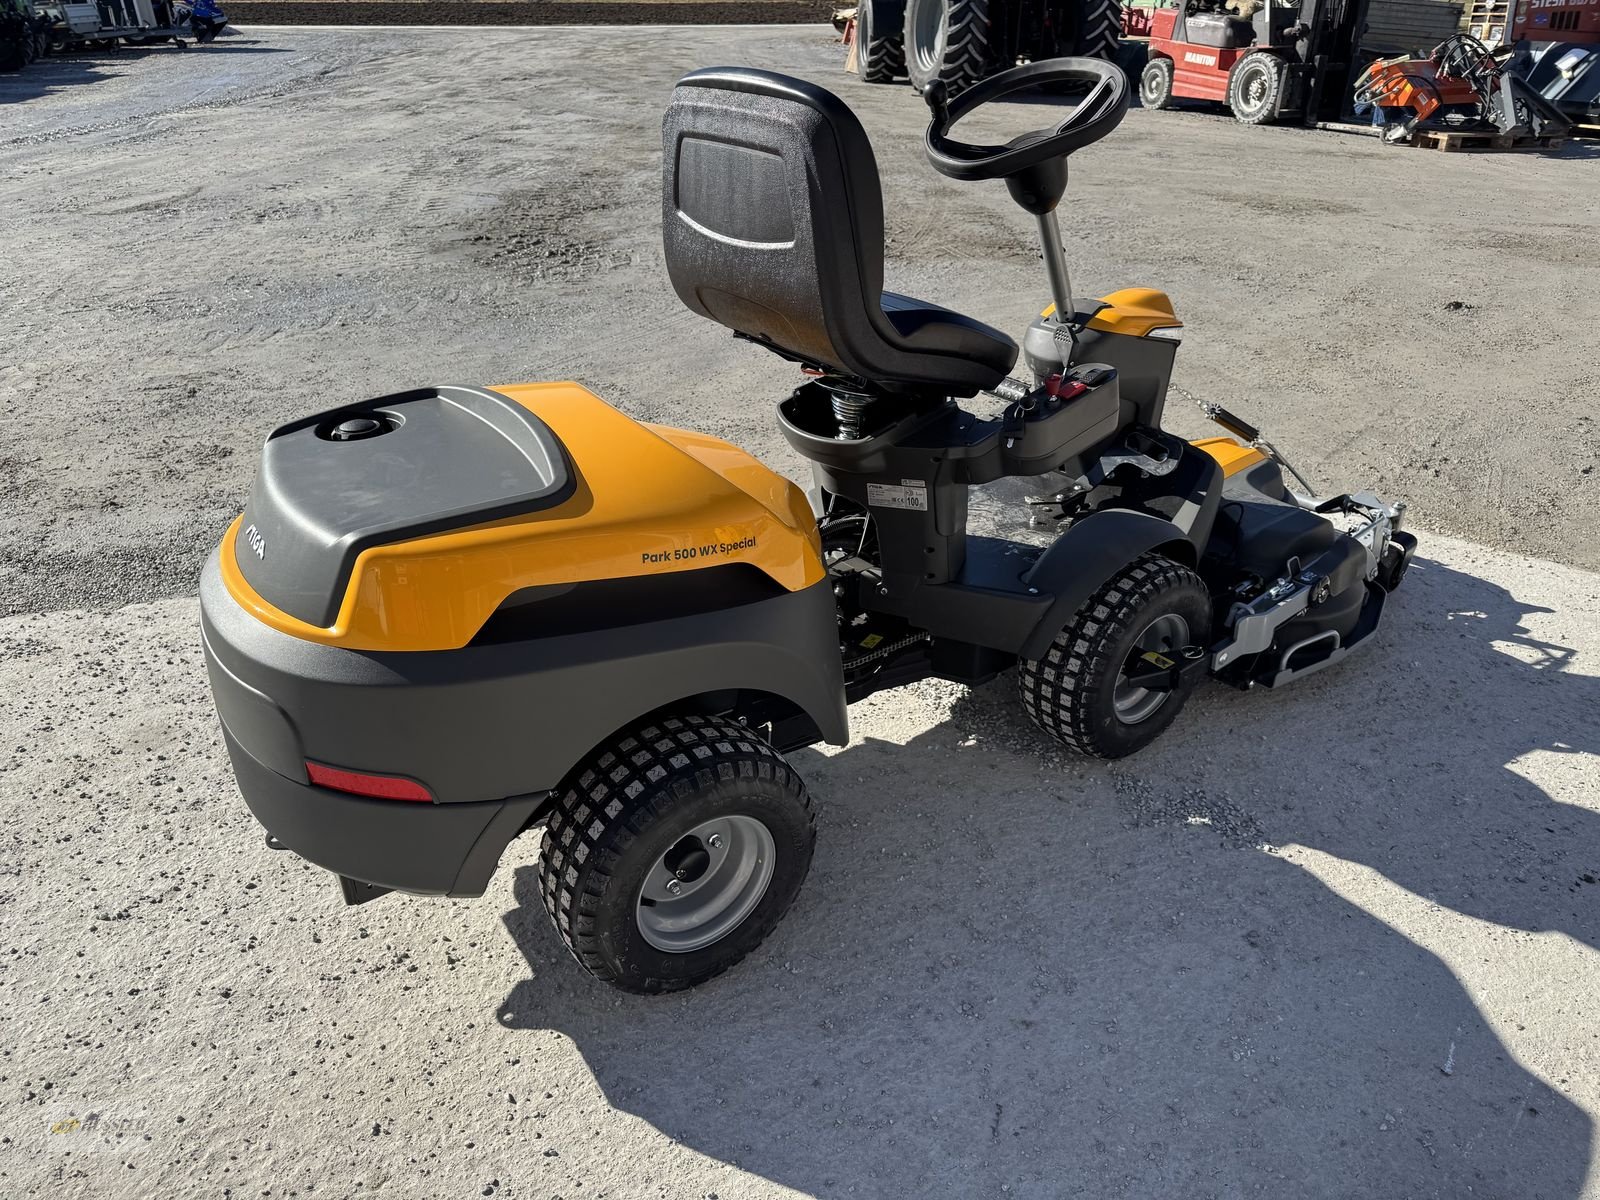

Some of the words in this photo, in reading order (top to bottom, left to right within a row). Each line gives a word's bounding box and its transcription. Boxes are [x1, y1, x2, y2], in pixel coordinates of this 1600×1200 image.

[1184, 51, 1216, 66] MANITOU
[907, 497, 919, 506] 100
[642, 551, 671, 563] Park
[674, 547, 697, 560] 500
[699, 544, 718, 556] WX
[720, 536, 756, 555] Special
